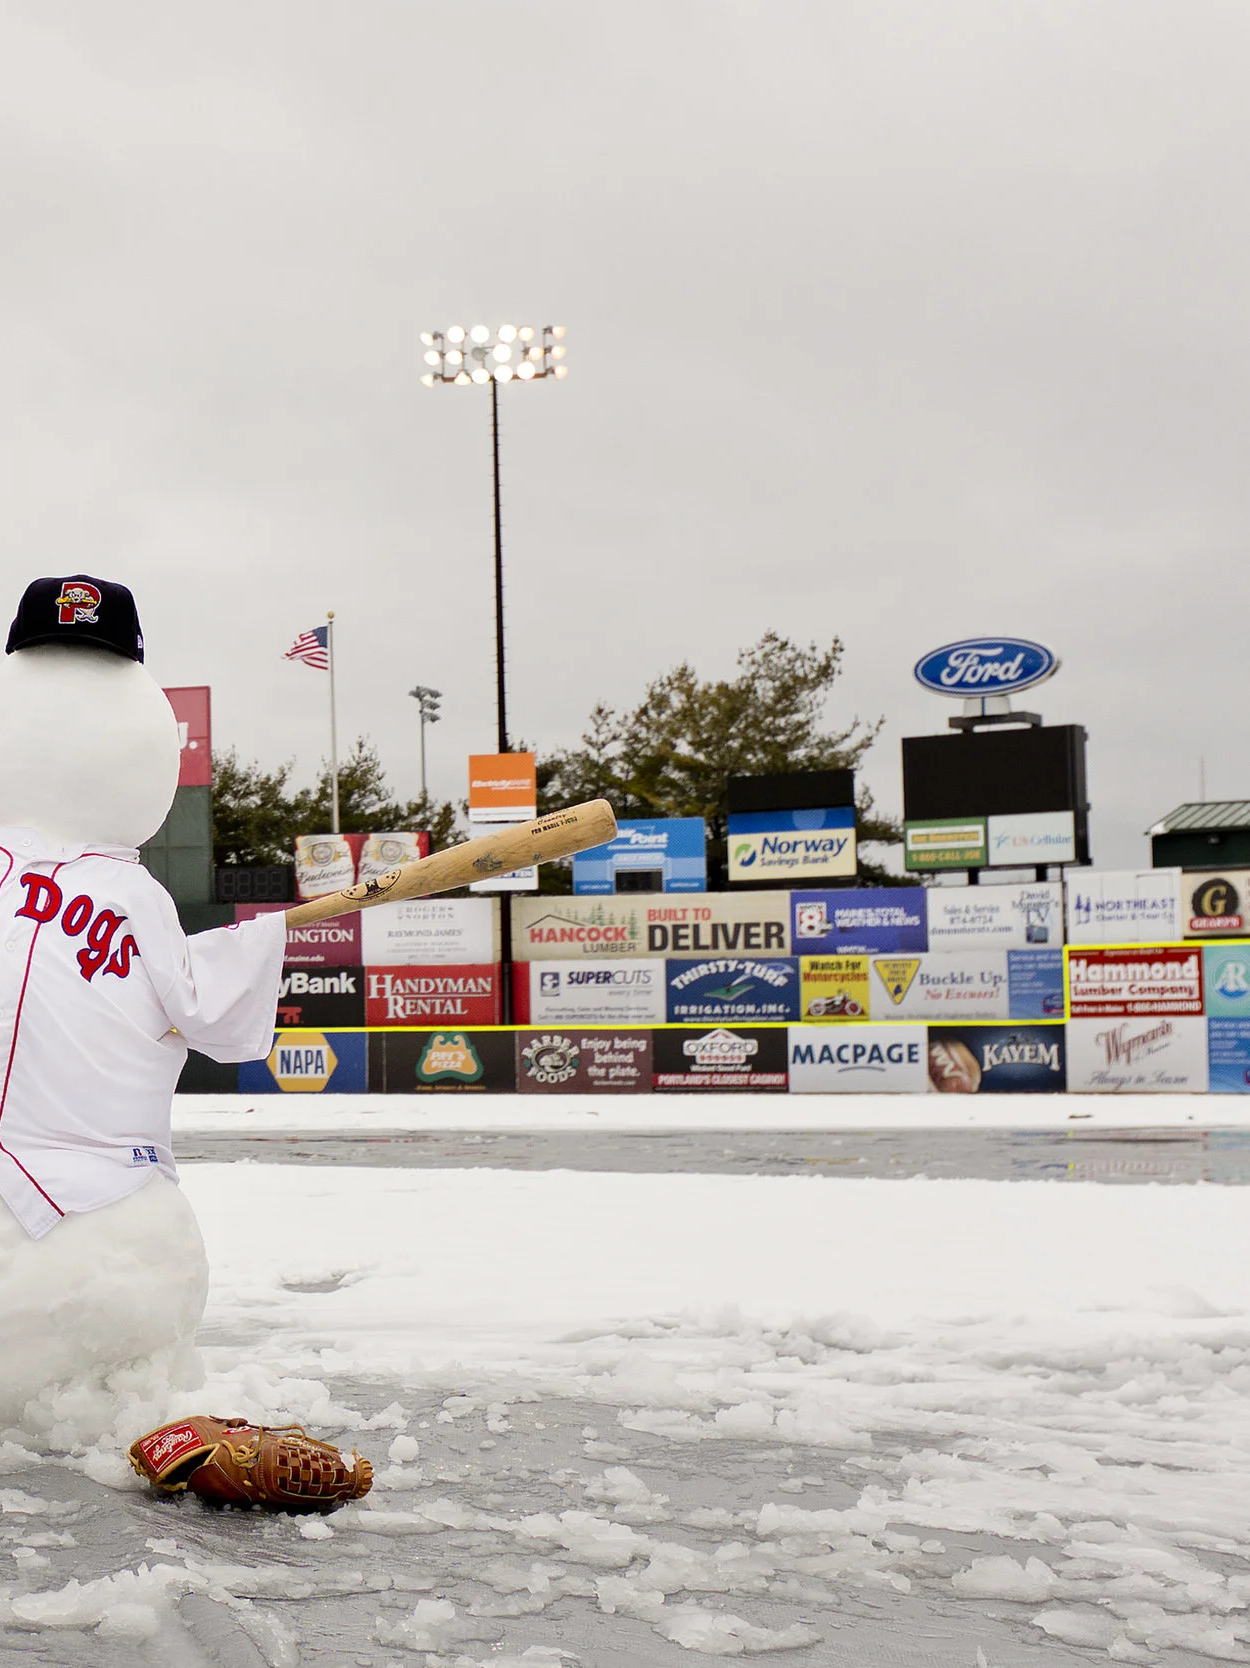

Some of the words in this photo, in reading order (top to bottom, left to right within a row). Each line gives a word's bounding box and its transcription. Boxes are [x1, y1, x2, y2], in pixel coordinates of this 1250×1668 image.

[940, 647, 1026, 685] Ford
[762, 837, 848, 857] Norway
[760, 857, 799, 868] Savings
[802, 855, 828, 865] Bank
[1095, 898, 1175, 911] NORTHEAST
[1202, 886, 1227, 917] G
[647, 908, 688, 922] BUILT
[693, 908, 711, 920] TO
[14, 872, 141, 982] Dogs
[530, 926, 628, 943] HANCOCK
[285, 928, 354, 943] INGTON
[648, 921, 785, 952] DELIVER
[582, 943, 637, 953] LUMBER
[809, 961, 842, 970] Watch
[845, 960, 862, 970] For
[1069, 955, 1199, 982] Hammond
[567, 970, 653, 985] SUPERCUTS
[670, 959, 789, 990] THIRSTY-TURF
[803, 972, 868, 983] Motorcycles
[920, 972, 974, 985] Buckle
[368, 974, 492, 999] HANDYMAN
[925, 989, 942, 1001] No
[945, 987, 1000, 1000] Excuses!
[1073, 984, 1123, 996] Lumber
[1129, 984, 1195, 996] Company
[386, 995, 468, 1019] RENTAL
[521, 1035, 580, 1058] BARBER
[581, 1037, 612, 1052] Enjoy
[613, 1036, 647, 1052] being
[686, 1042, 755, 1054] OXFORD
[1094, 1019, 1173, 1066] Wyman's
[280, 1049, 325, 1074] NAPA
[594, 1051, 634, 1063] behind
[792, 1043, 919, 1064] MACPAGE
[982, 1043, 1060, 1072] KAYEM
[431, 1060, 462, 1069] PIZZA
[587, 1065, 606, 1076] the
[608, 1065, 641, 1079] plate.
[526, 1066, 577, 1084] FOODS
[658, 1073, 710, 1085] PORTLAND'S
[152, 1431, 192, 1461] Rawlings
